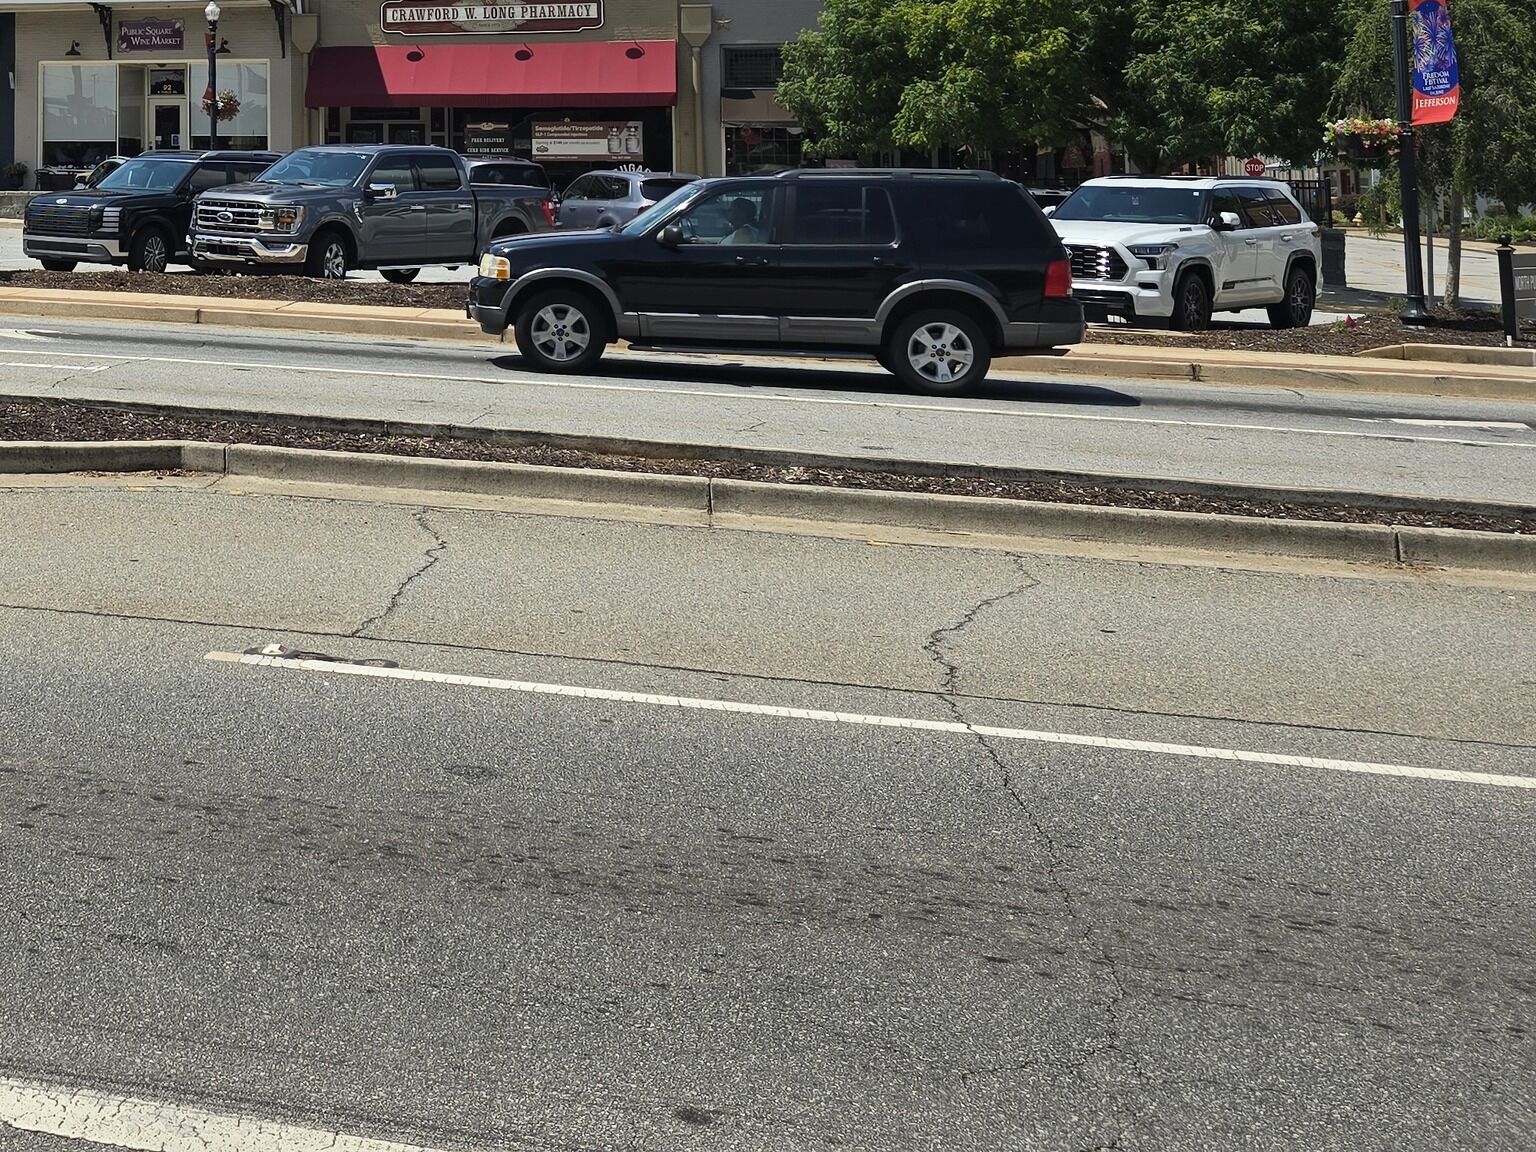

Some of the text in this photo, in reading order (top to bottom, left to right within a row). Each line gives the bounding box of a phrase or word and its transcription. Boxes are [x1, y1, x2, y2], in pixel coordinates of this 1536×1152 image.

[392, 4, 592, 21] CRAWFORD W. LONG PHARMACY
[1415, 96, 1456, 110] JEFFERSON
[1246, 164, 1264, 172] STOP
